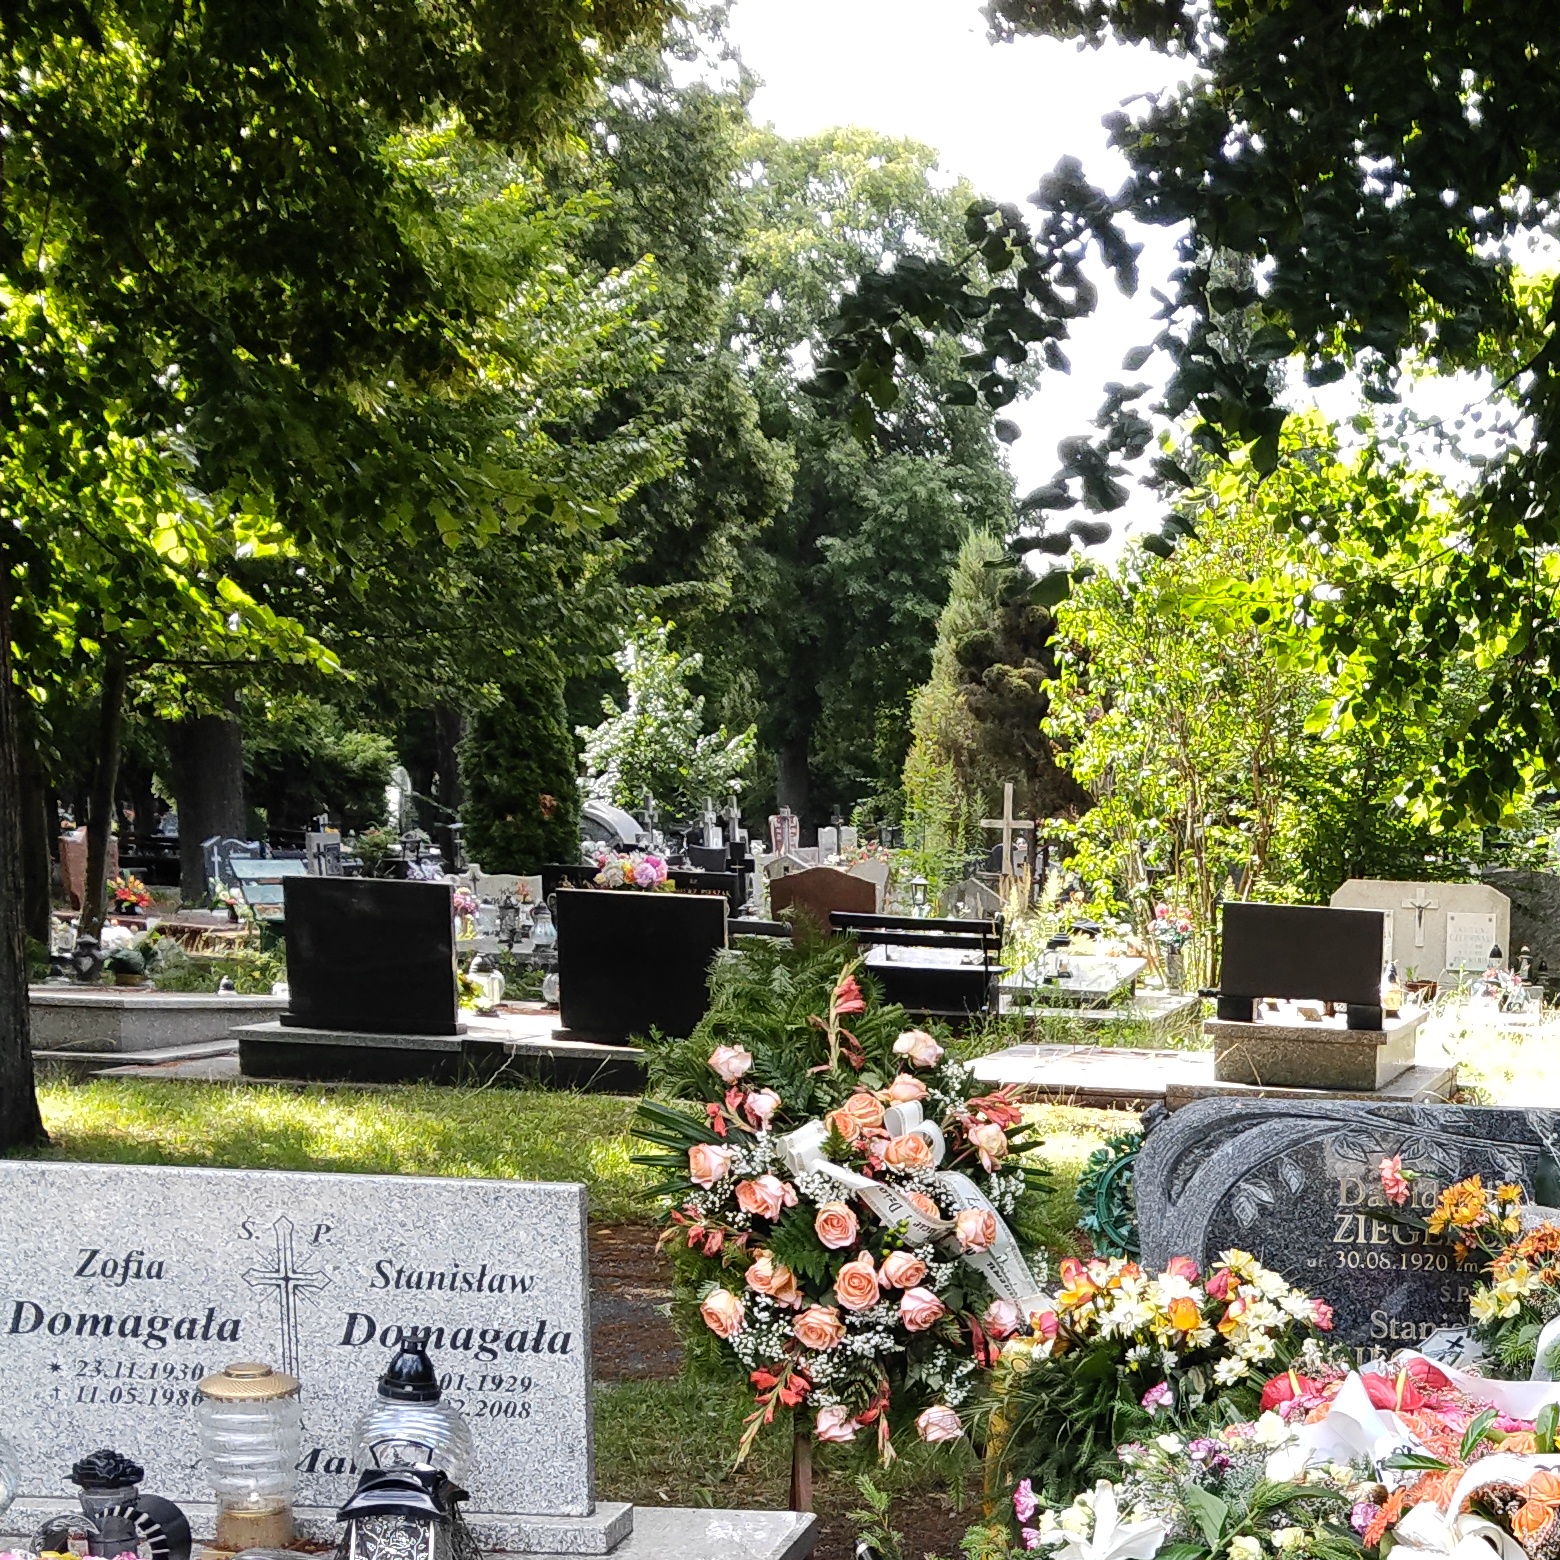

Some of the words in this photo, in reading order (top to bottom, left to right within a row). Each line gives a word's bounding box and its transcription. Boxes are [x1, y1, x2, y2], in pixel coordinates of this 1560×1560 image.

[1337, 1176, 1440, 1208] Daid
[74, 1248, 166, 1288] Zofia
[369, 1258, 537, 1294] Stanisław
[1335, 1250, 1449, 1272] 30.08.1920
[4, 1300, 243, 1350] Domagała
